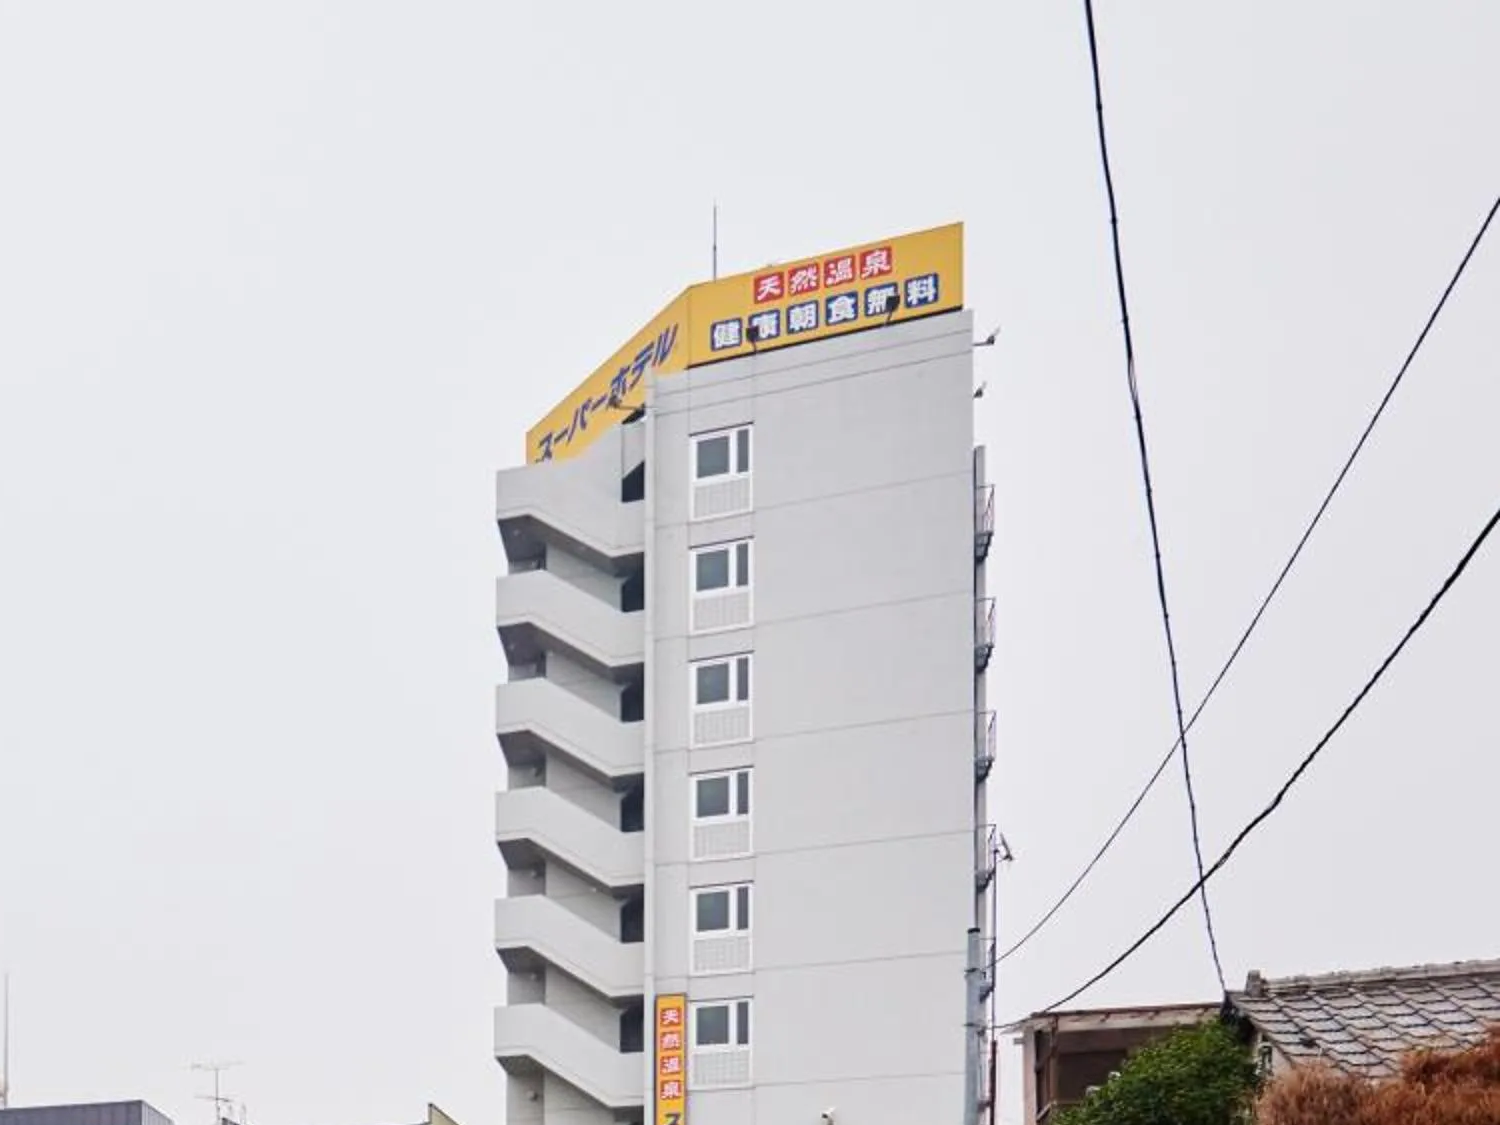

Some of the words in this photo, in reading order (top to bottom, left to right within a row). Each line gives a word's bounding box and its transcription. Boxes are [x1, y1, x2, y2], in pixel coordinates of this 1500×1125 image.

[756, 248, 891, 301] 天然温泉
[535, 323, 679, 463] スーパーホテル
[660, 1008, 681, 1099] 天然温泉
